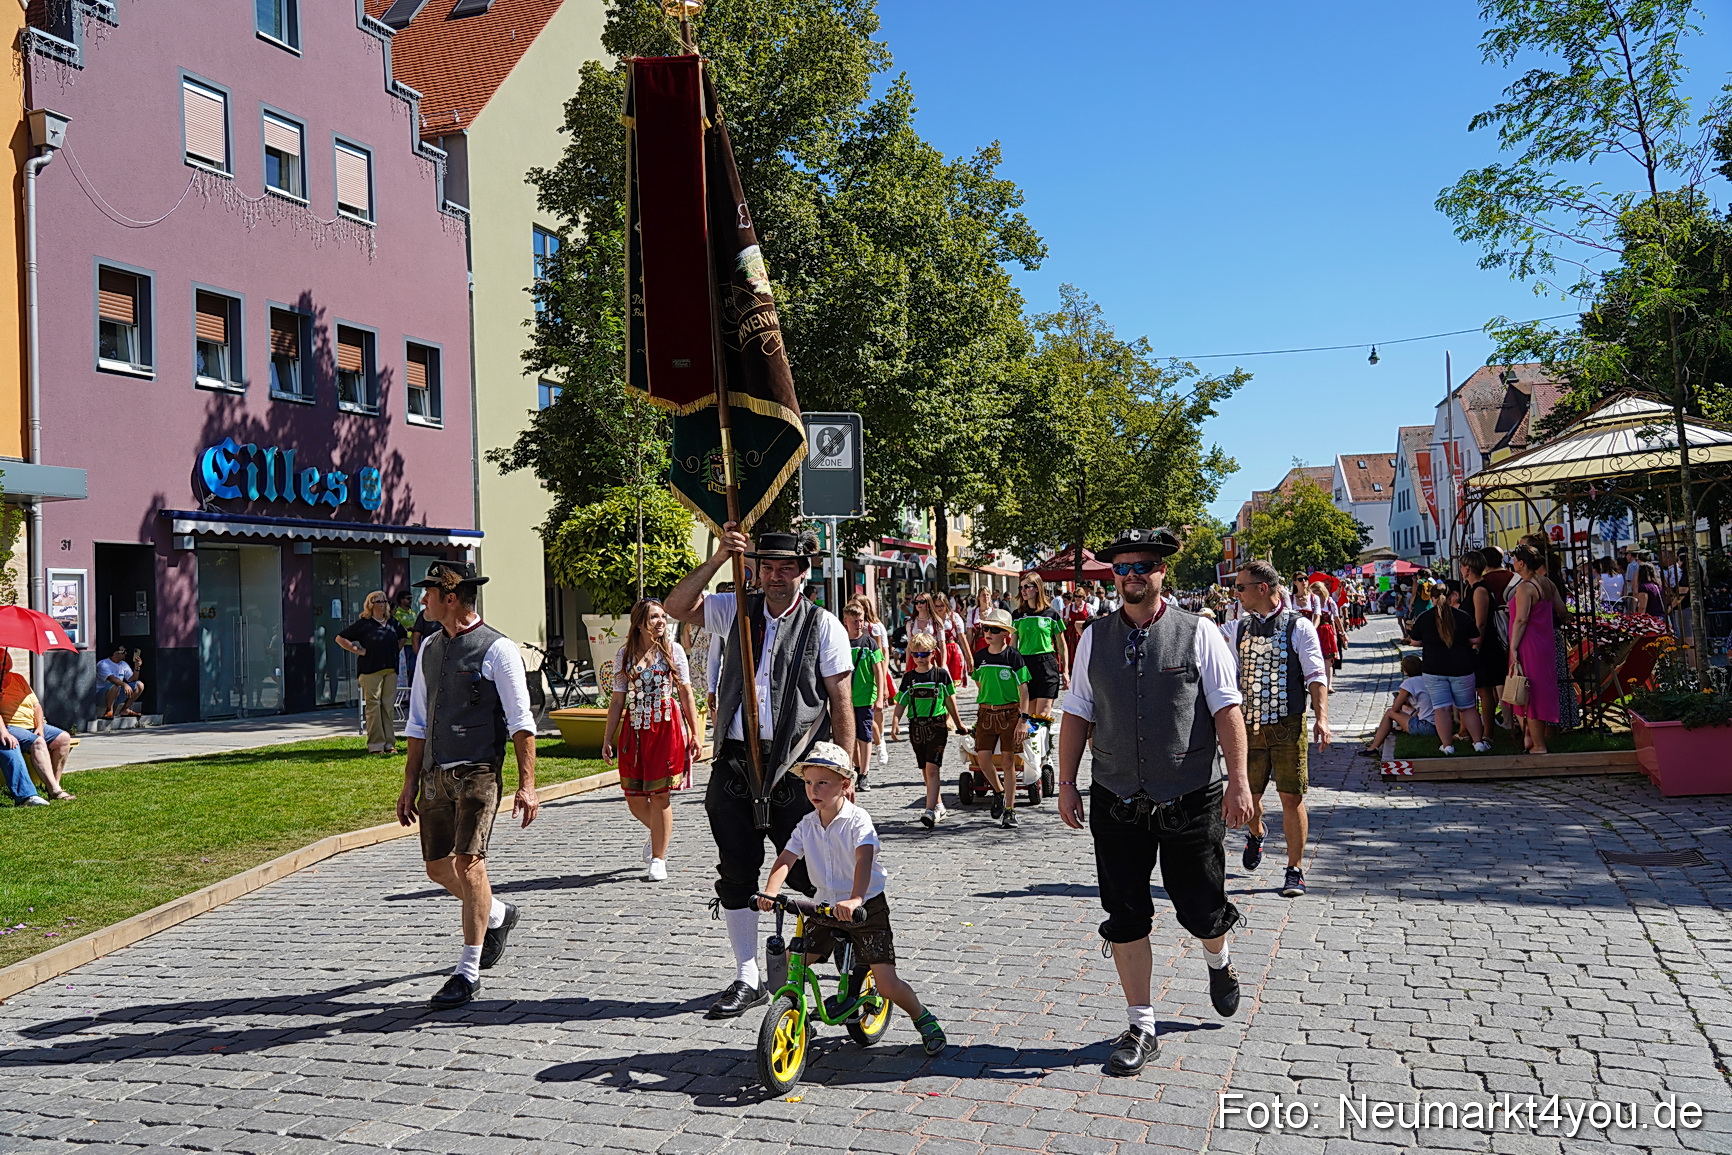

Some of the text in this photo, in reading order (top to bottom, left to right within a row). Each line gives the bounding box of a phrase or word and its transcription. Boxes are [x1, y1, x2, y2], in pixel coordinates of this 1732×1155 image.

[820, 458, 843, 467] ZONE
[200, 437, 349, 507] Eilles
[60, 539, 72, 551] 31
